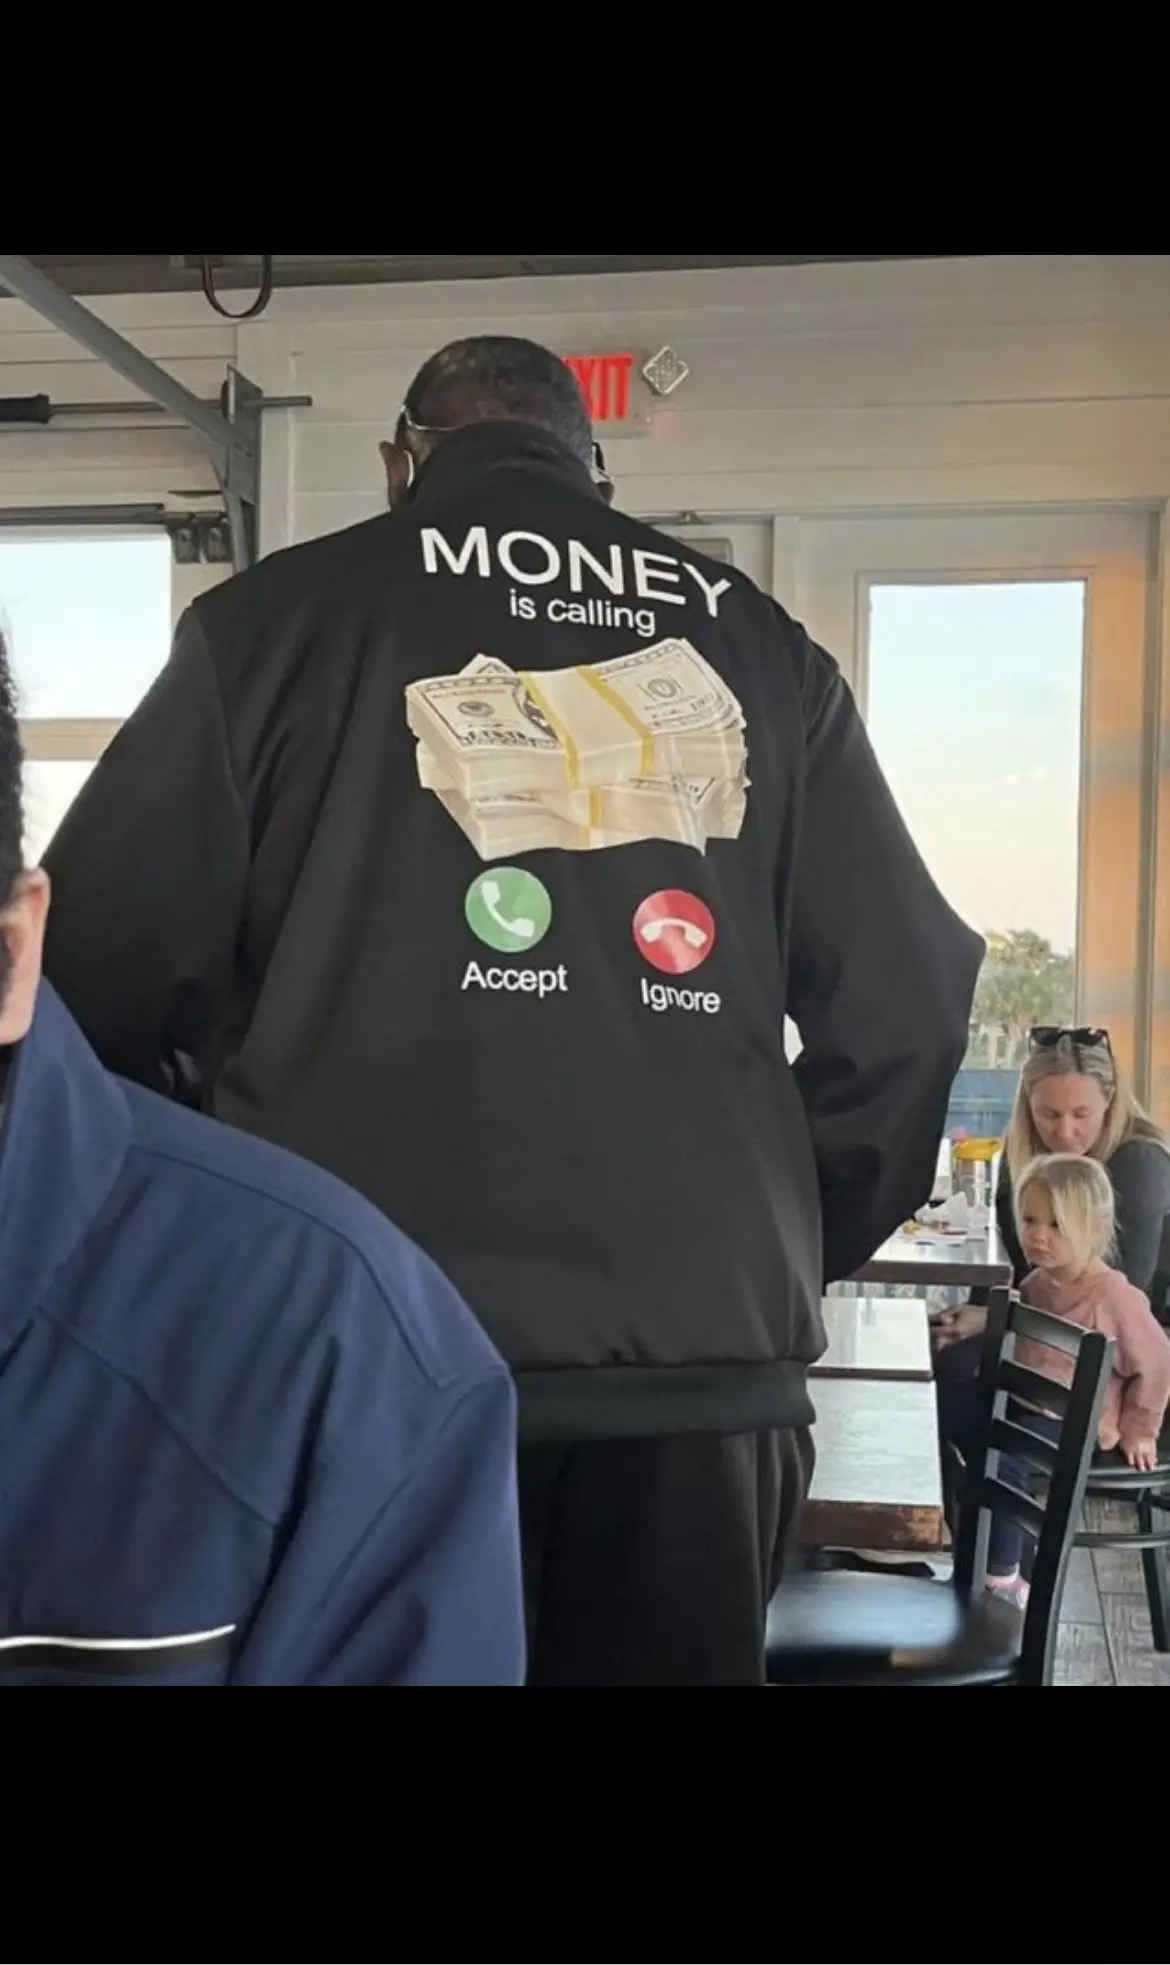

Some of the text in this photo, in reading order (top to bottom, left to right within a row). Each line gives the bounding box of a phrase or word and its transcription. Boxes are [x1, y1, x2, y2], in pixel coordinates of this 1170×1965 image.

[562, 353, 633, 420] XIT
[420, 526, 732, 618] MONEY
[509, 588, 656, 638] is calling
[461, 960, 568, 999] Accept
[641, 977, 721, 1014] Ignore
